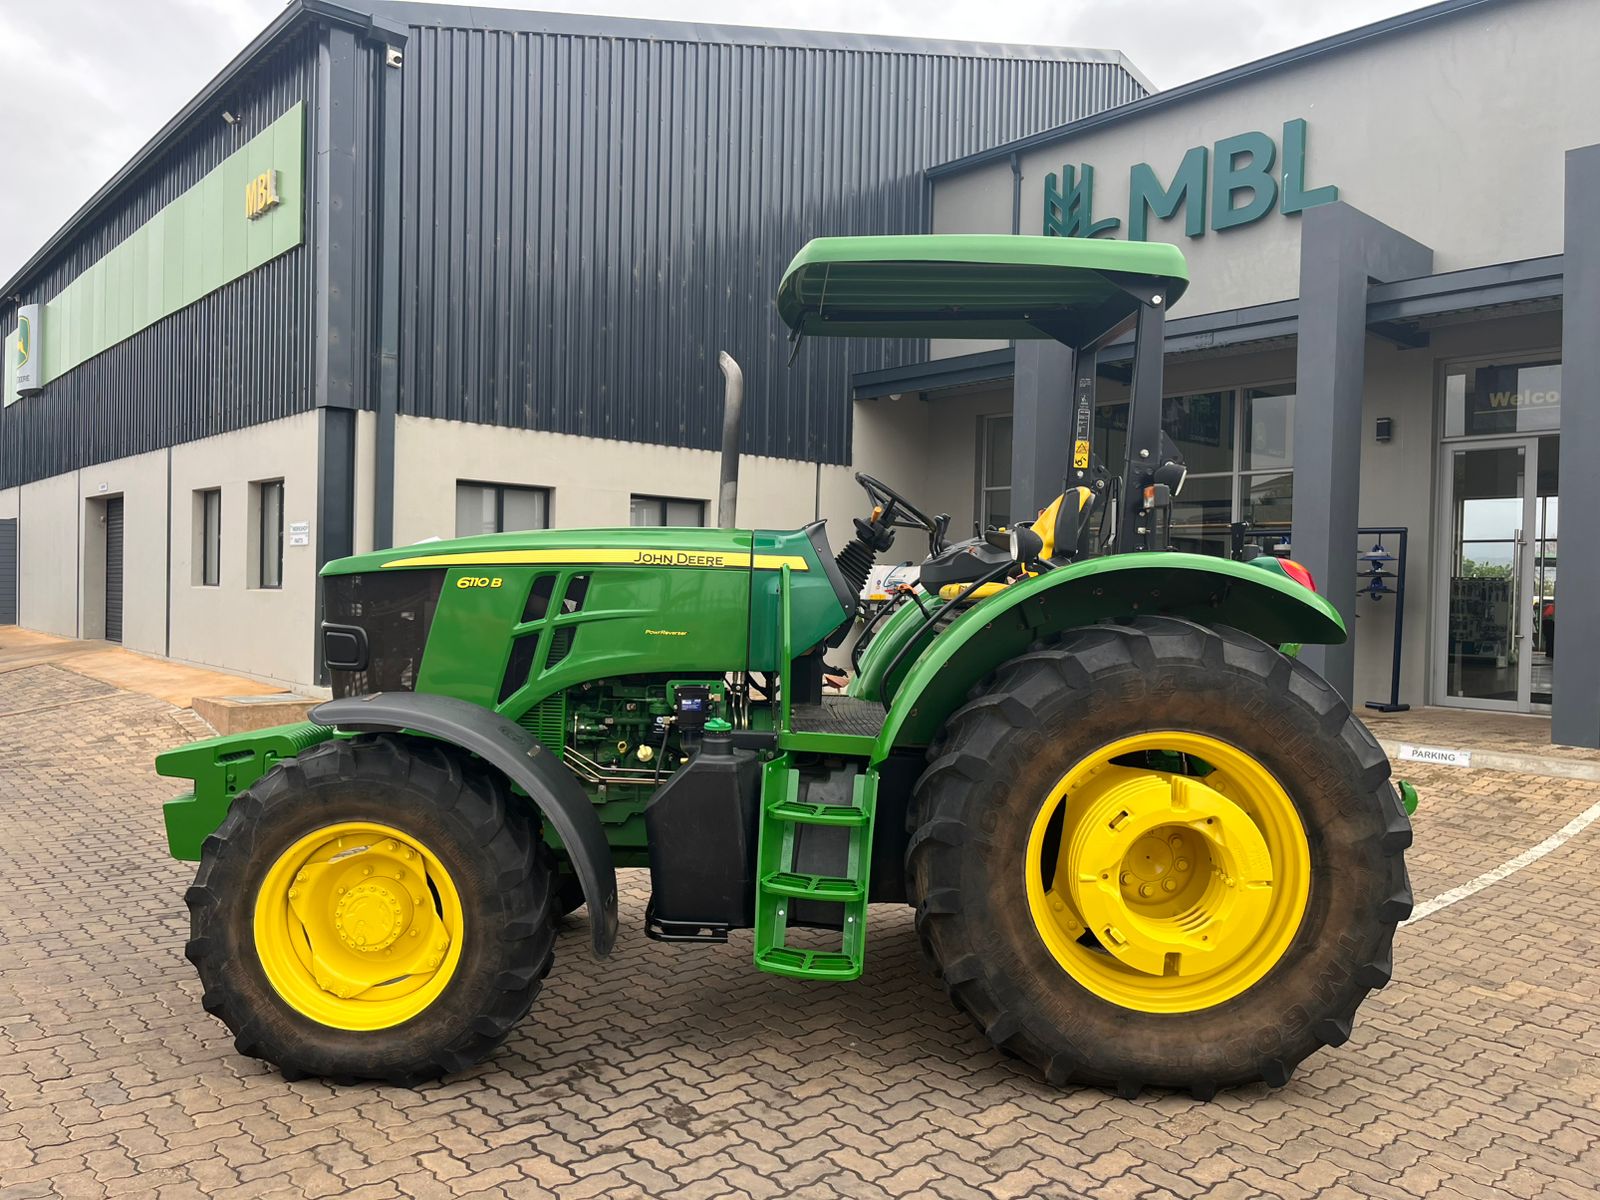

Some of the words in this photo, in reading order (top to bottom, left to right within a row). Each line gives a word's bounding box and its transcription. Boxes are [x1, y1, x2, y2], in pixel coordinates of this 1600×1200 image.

[1128, 118, 1338, 241] MBL
[245, 168, 280, 221] MBL
[633, 551, 674, 565] JOHN
[676, 552, 725, 566] DEERE
[456, 576, 490, 589] 6110
[490, 577, 503, 588] B
[1411, 749, 1456, 761] PARKING
